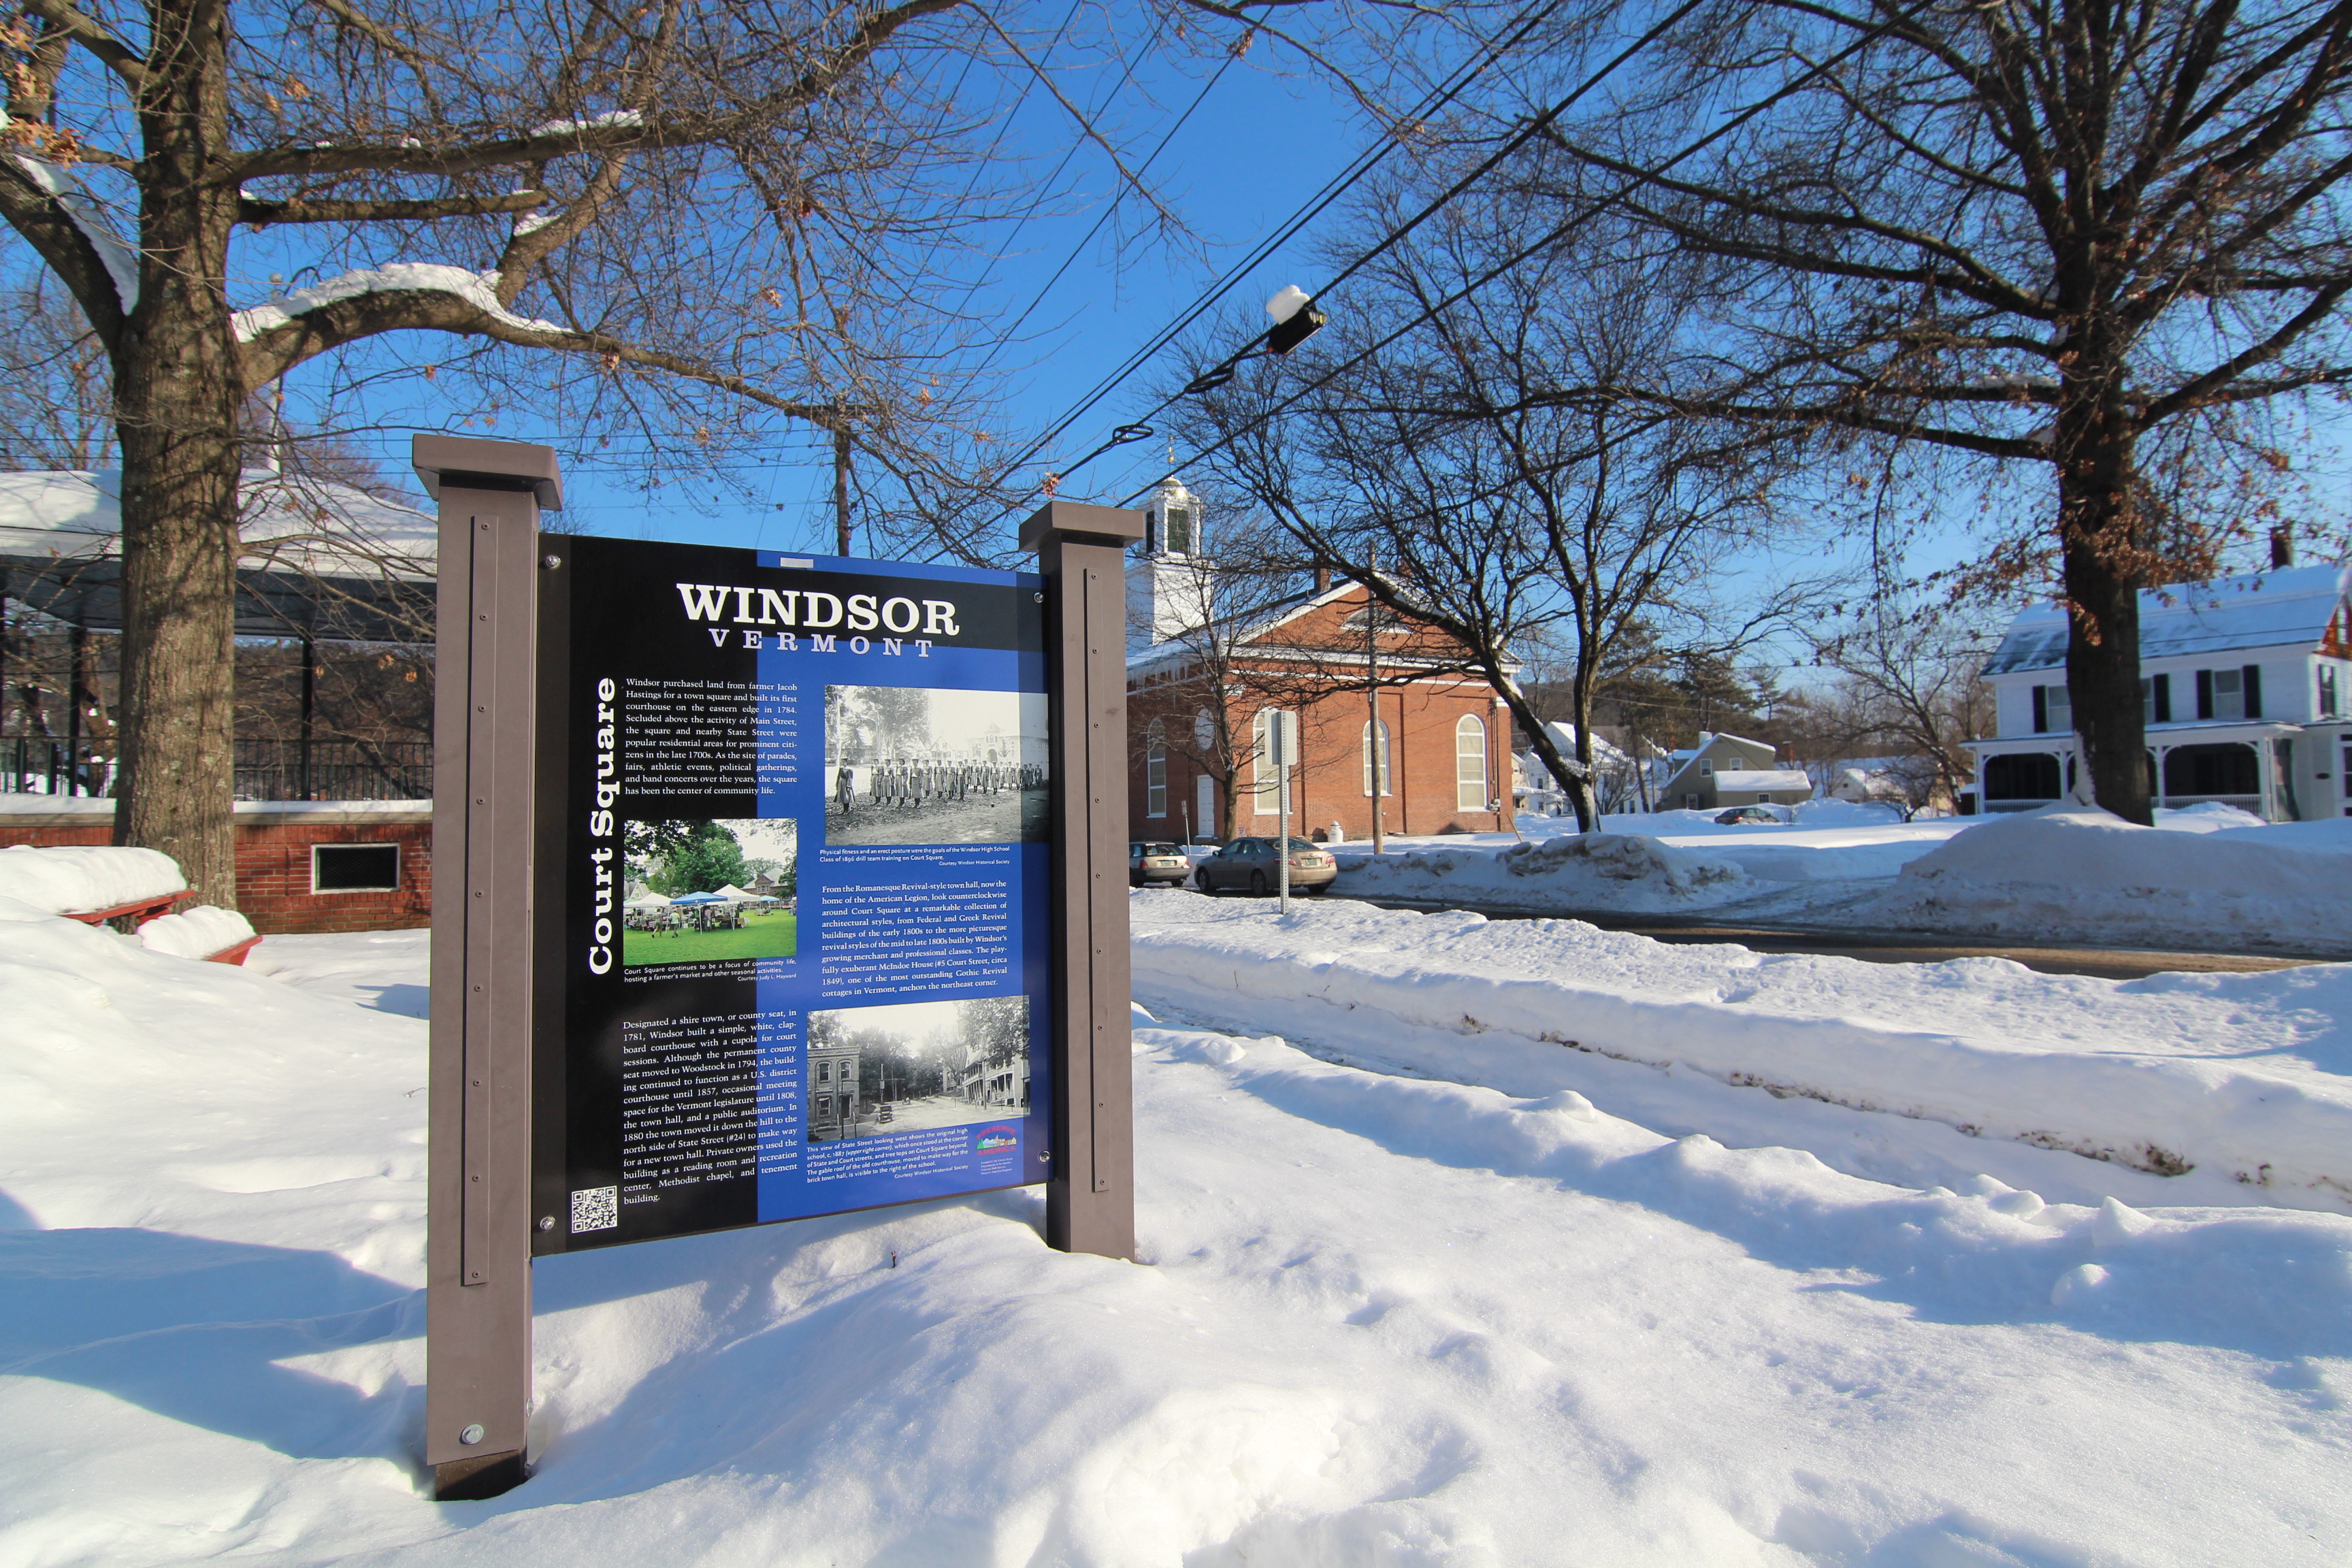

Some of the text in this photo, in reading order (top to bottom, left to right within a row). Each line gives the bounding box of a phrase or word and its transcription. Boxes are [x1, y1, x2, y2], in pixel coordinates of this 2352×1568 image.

[676, 583, 960, 636] WINDSOR
[708, 629, 932, 657] VERMONT
[664, 679, 703, 688] purchased
[749, 682, 774, 690] farmer
[626, 691, 662, 700] Hastings
[625, 702, 671, 710] courthouse
[742, 705, 760, 714] edge
[625, 714, 662, 722] Secluded
[665, 715, 688, 723] above
[707, 717, 736, 725] activity
[773, 718, 797, 726] Street,
[696, 728, 722, 736] nearby
[589, 678, 619, 975] Court Square
[821, 908, 848, 916] around
[922, 904, 961, 912] remarkable
[821, 918, 868, 928] architectural
[872, 917, 894, 926] styles,
[821, 931, 856, 939] buildings
[883, 928, 900, 937] early
[968, 926, 1007, 934] picturesque
[821, 954, 852, 964] growing
[854, 952, 888, 960] merchant
[905, 948, 947, 959] professional
[991, 945, 1007, 954] play-
[623, 1017, 669, 1029] Designated
[680, 1016, 699, 1024] shire
[623, 1045, 647, 1054] board
[651, 1042, 696, 1051] courthouse
[700, 1039, 719, 1047] with
[732, 1035, 757, 1045] cupola
[623, 1058, 659, 1066] sessions.
[664, 1052, 702, 1062] Although
[724, 1048, 766, 1059] permanent
[623, 1084, 637, 1092] ing
[640, 1078, 681, 1090] continued
[696, 1075, 729, 1084] function
[751, 1071, 766, 1079] U.S.
[770, 1068, 797, 1077] district
[623, 1081, 798, 1104] courthouse until 1857, occasional meeting
[936, 1129, 956, 1137] original
[977, 1126, 1016, 1139] PRESERVE
[977, 1146, 1015, 1156] AMERICA
